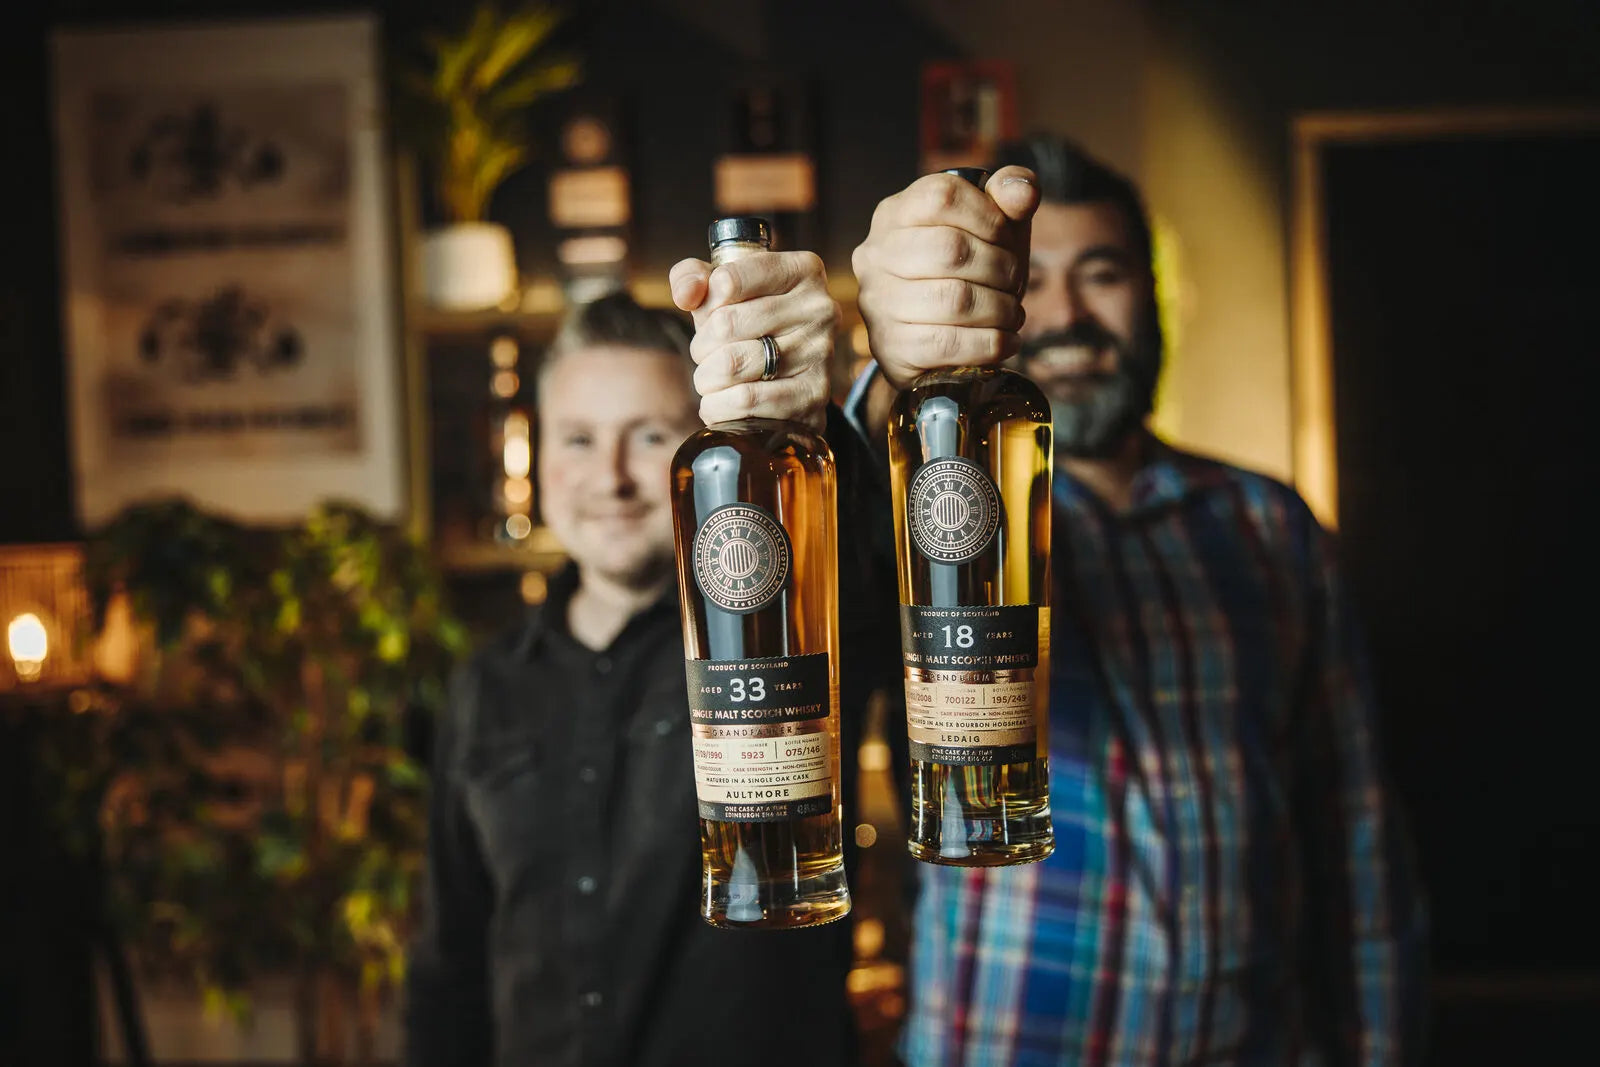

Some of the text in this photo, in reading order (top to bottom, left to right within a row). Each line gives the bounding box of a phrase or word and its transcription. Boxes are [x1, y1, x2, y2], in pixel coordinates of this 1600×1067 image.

[923, 464, 951, 478] UNIQUE
[954, 465, 981, 479] SINGLE
[709, 510, 736, 526] UNIQUE
[941, 624, 974, 649] 18
[926, 655, 948, 665] MALT
[951, 655, 992, 665] SCOTCH
[994, 653, 1031, 664] WHISKY
[750, 661, 789, 670] SCOTLAND
[701, 677, 803, 702] AGED 33 YEARS
[945, 696, 976, 705] 700122
[692, 704, 821, 720] SINGLE MALT SCOTCH WHISKY
[712, 726, 793, 737] GRANDFATHER
[941, 734, 981, 743] LEDAIG
[741, 751, 765, 760] 5923
[785, 745, 820, 757] 075/146
[792, 773, 809, 781] CASK
[726, 788, 790, 799] AULTMORE
